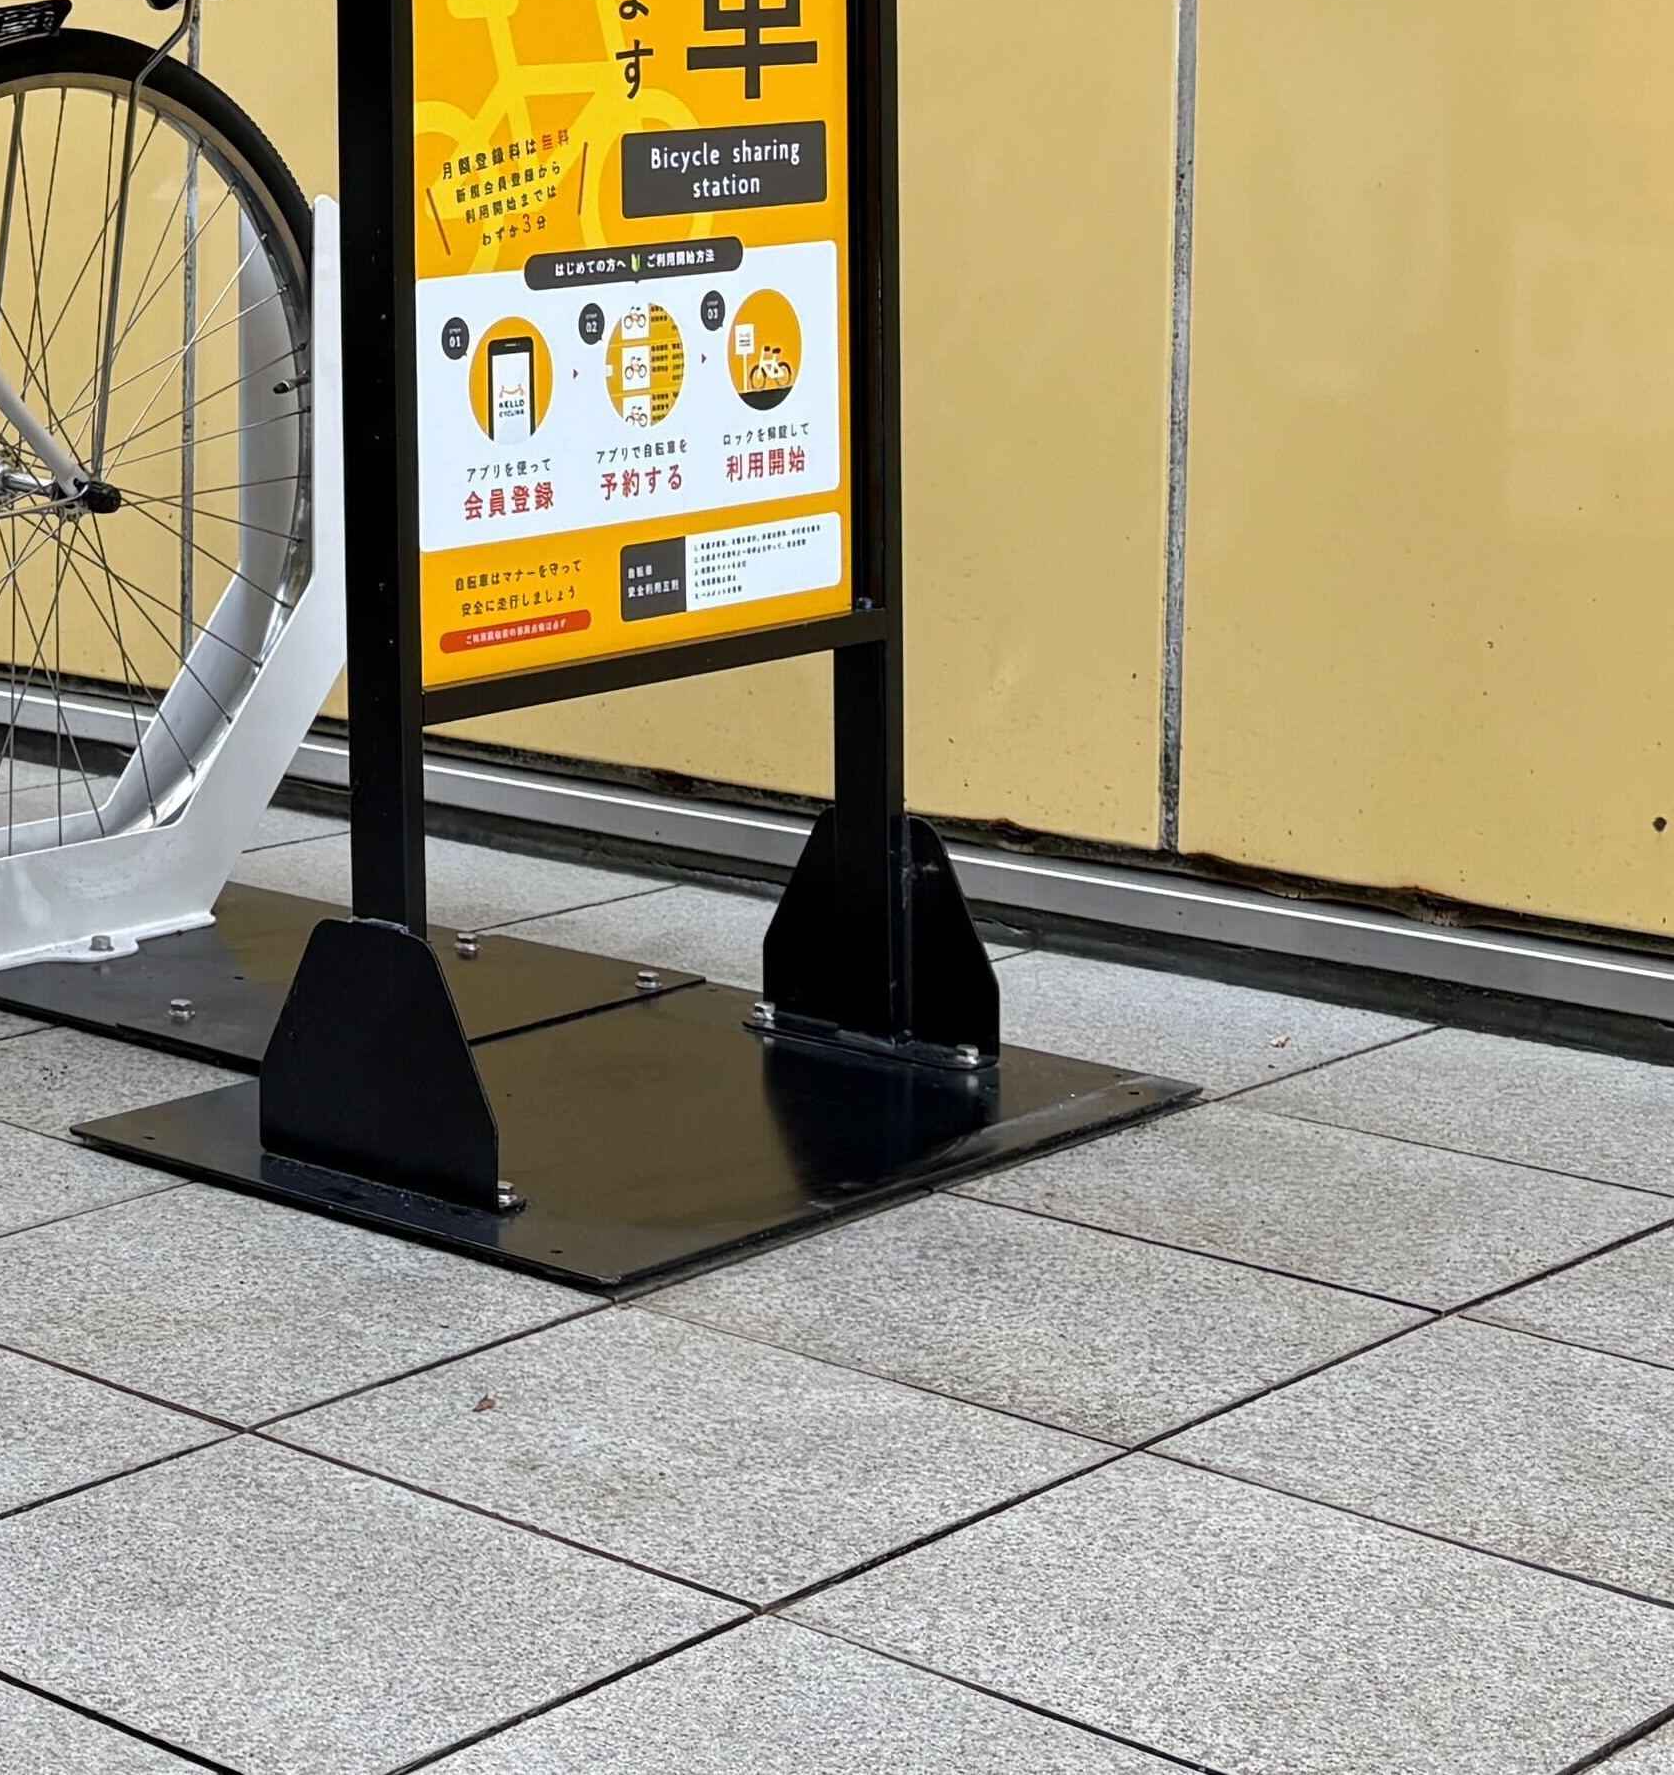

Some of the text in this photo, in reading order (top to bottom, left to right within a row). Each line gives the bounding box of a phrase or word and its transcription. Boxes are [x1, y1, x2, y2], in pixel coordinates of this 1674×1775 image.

[651, 138, 800, 174] Bicycle sharing
[692, 173, 760, 199] station
[555, 258, 626, 277] はじめての方へ
[726, 445, 805, 482] 利用開始
[600, 463, 683, 501] 予約する
[464, 481, 554, 521] 会員登録
